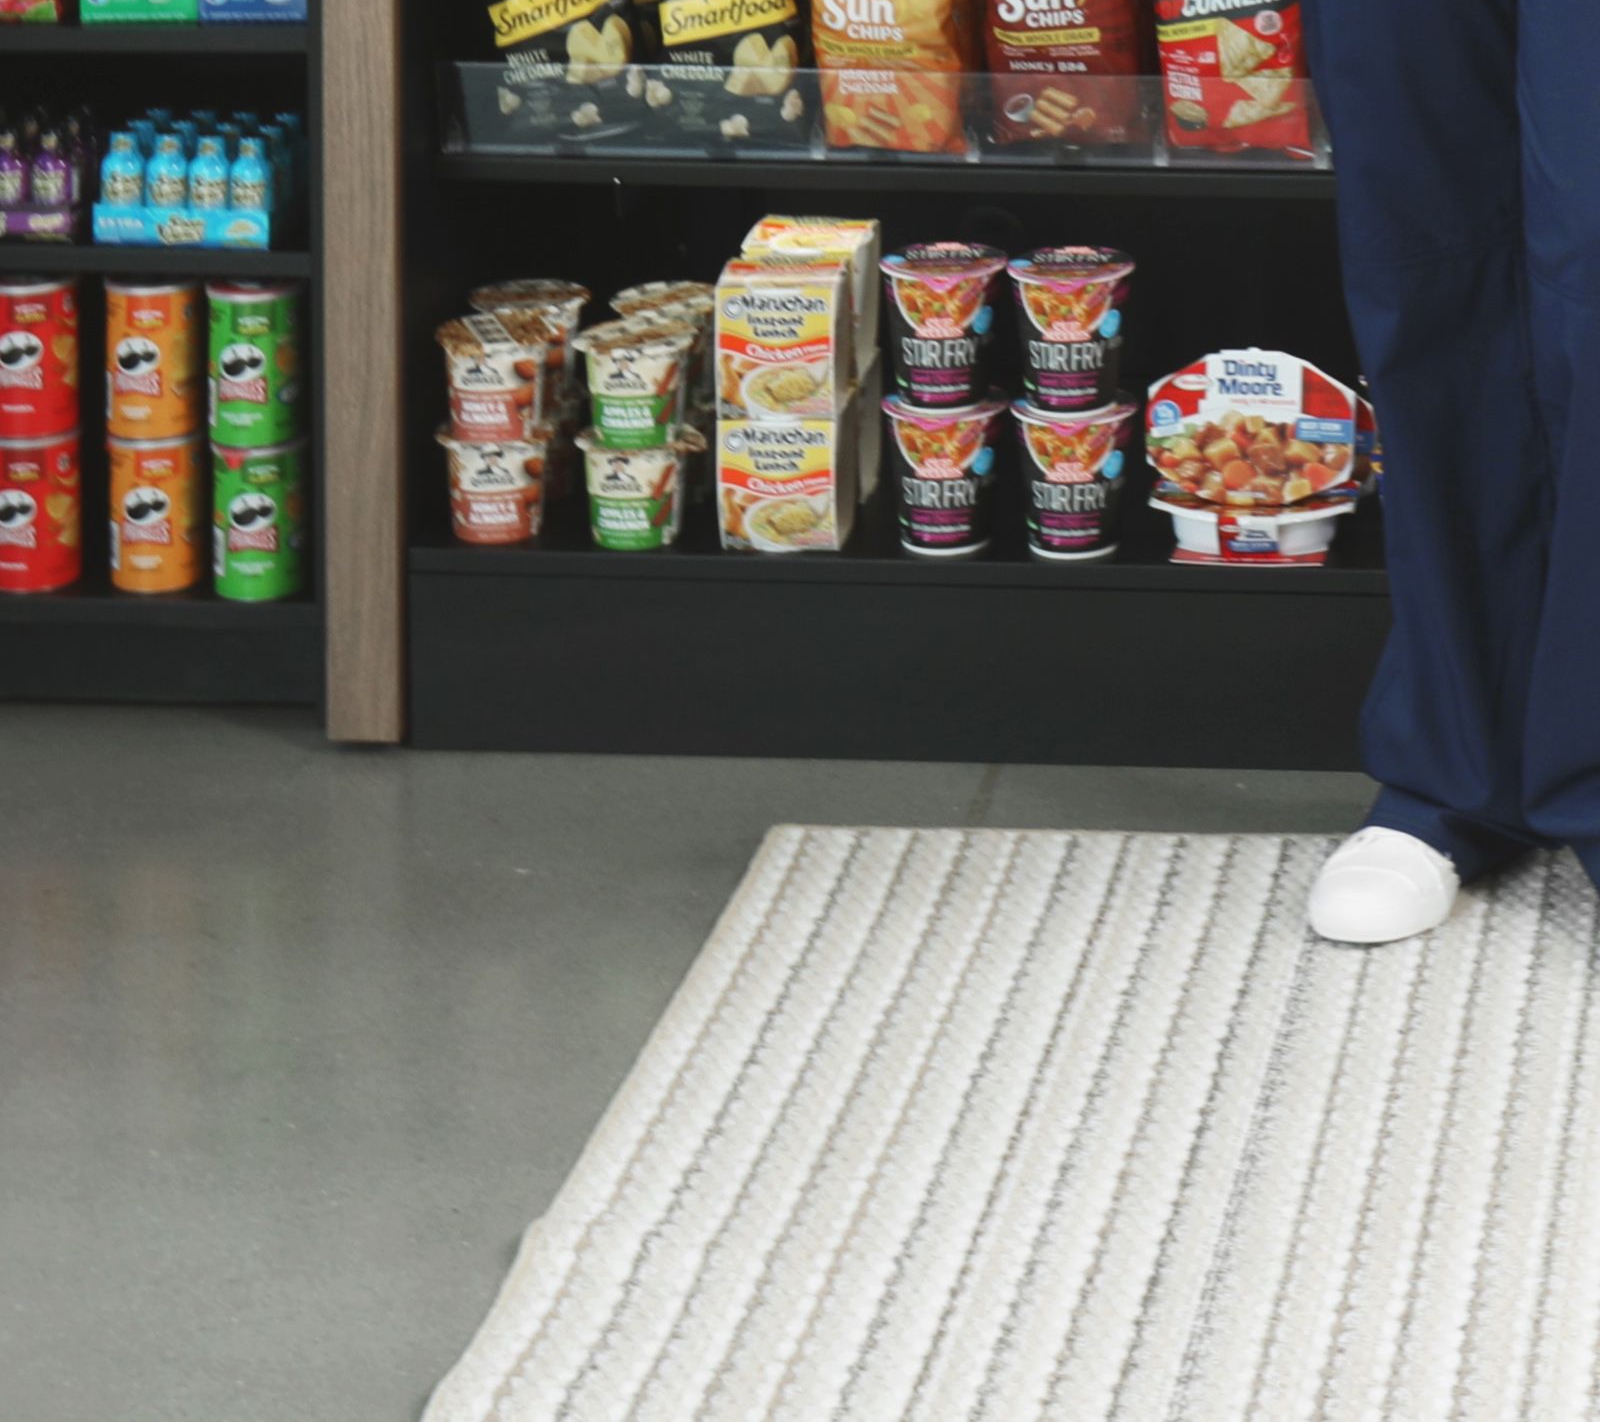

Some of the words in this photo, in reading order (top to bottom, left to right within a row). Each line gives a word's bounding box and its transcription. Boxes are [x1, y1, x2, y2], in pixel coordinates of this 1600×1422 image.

[1025, 8, 1085, 29] CHIPS
[846, 24, 905, 42] CHIPS
[741, 295, 827, 314] Maruchan
[902, 337, 942, 369] STIR
[943, 337, 978, 368] FRY
[1028, 339, 1069, 372] STIR
[1070, 341, 1105, 372] FRY
[1223, 359, 1277, 382] Dinty
[1217, 377, 1284, 397] Moore
[742, 428, 827, 448] Maruchan
[902, 478, 943, 510] STIR
[944, 479, 977, 509] FRY
[1031, 481, 1074, 513] STIR
[1074, 482, 1108, 512] FRY
